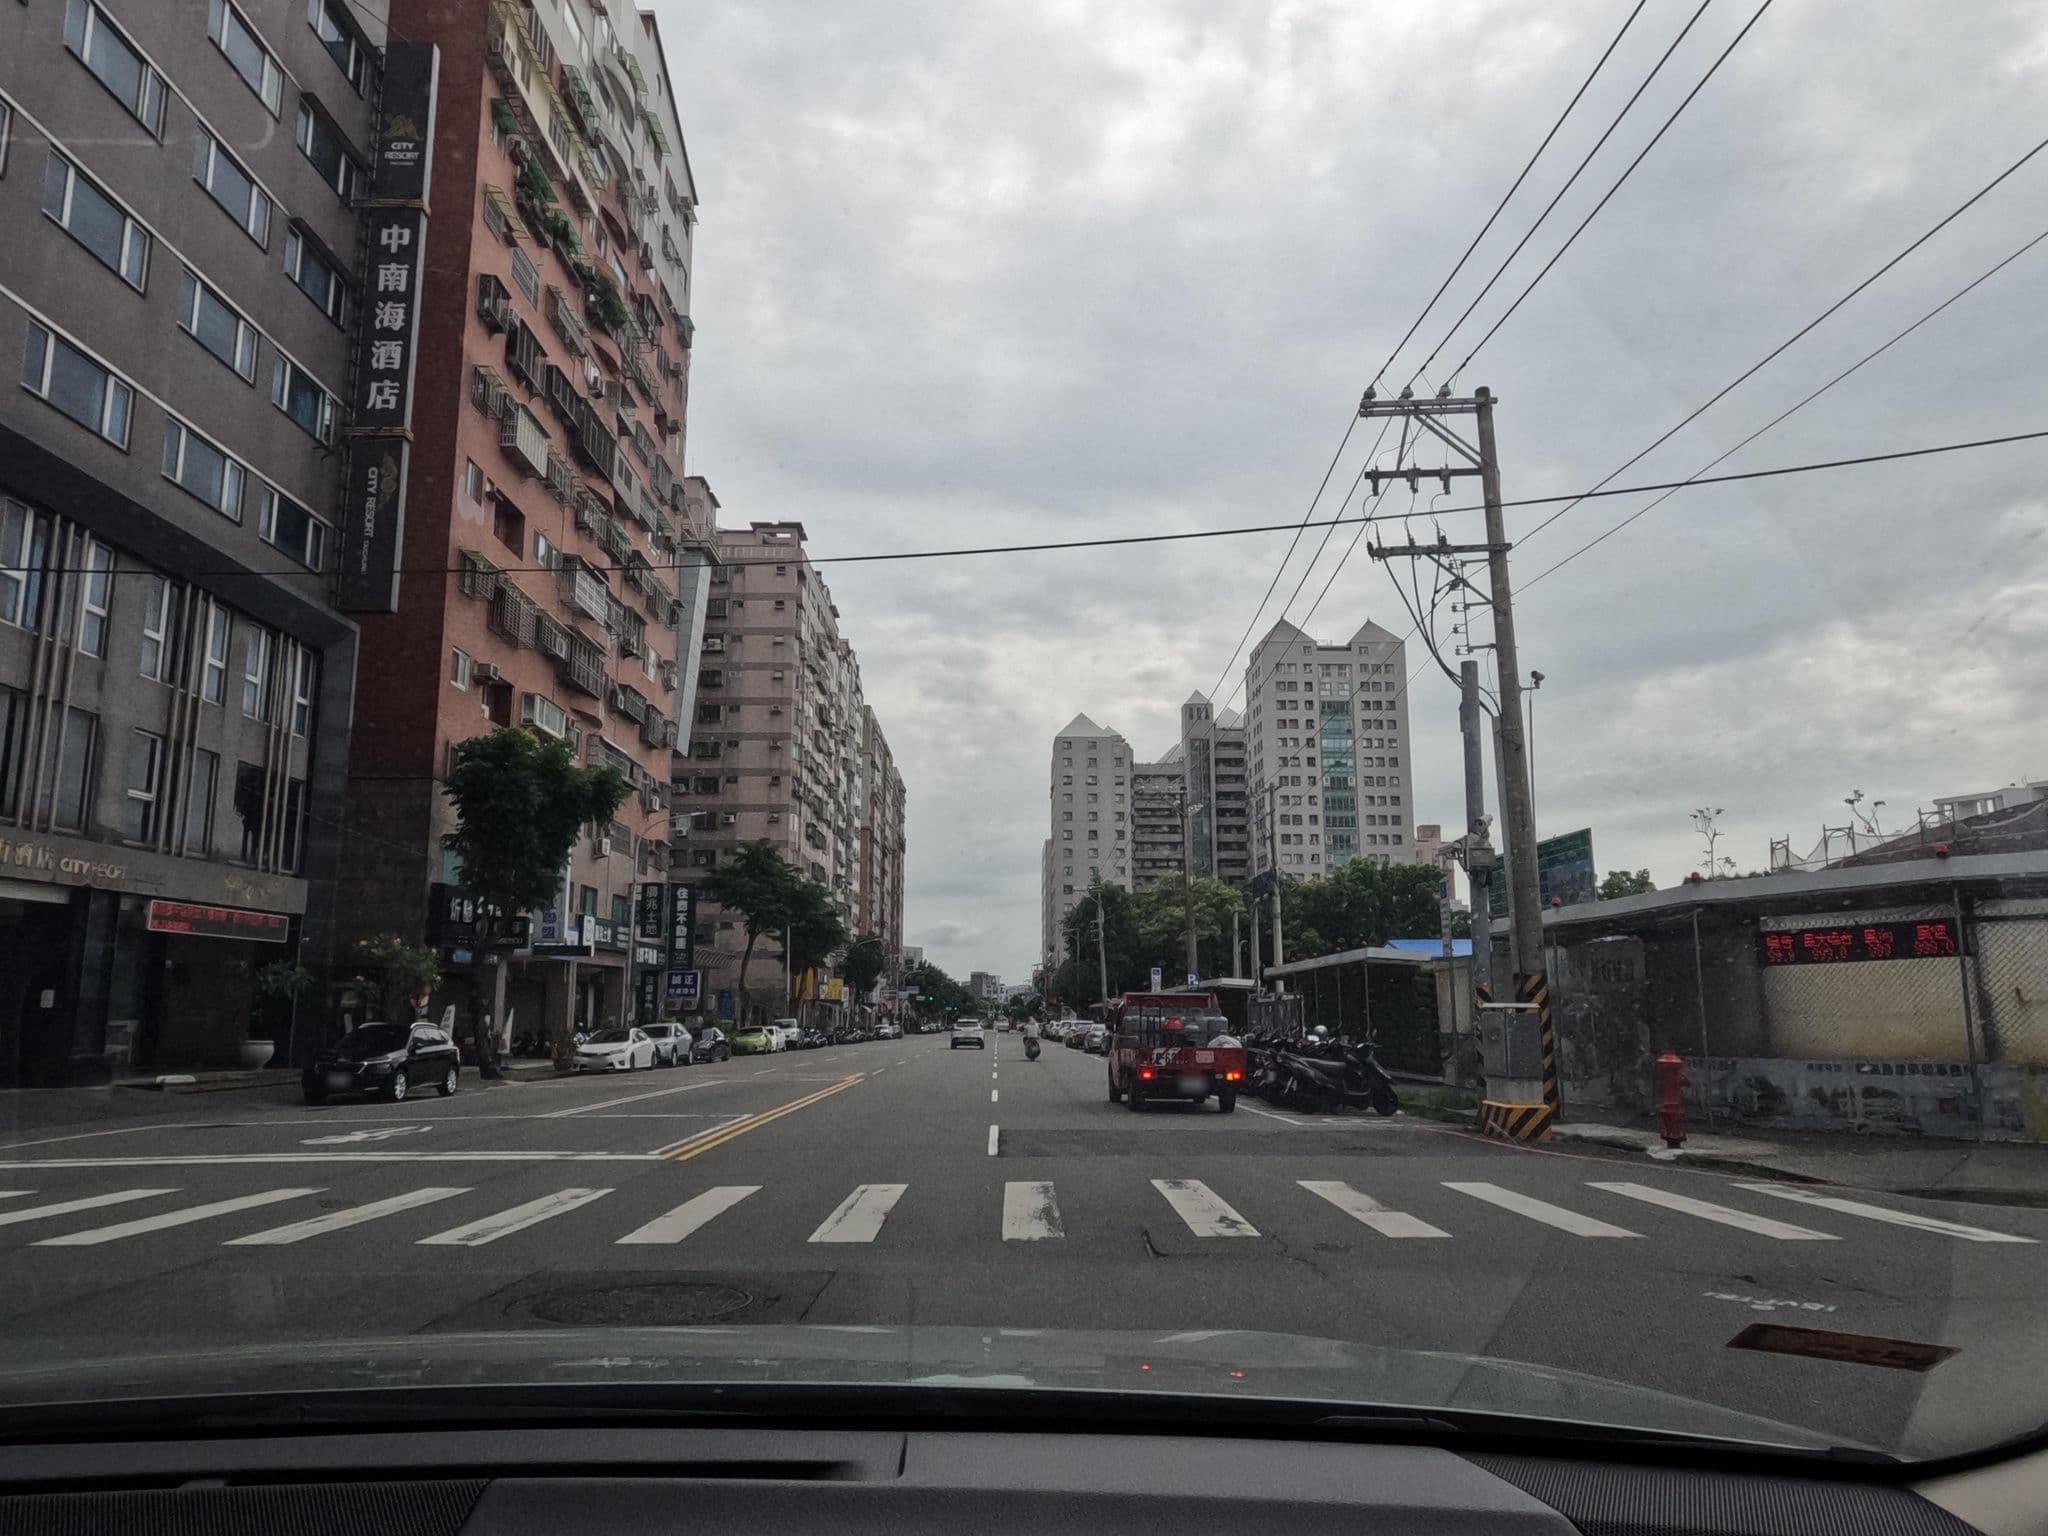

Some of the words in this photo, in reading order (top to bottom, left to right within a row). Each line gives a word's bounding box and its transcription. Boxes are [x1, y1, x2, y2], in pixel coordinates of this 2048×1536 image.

[391, 142, 415, 150] CITY
[366, 223, 412, 411] 中南海酒店
[367, 466, 379, 494] CITY
[363, 496, 377, 538] RESORT
